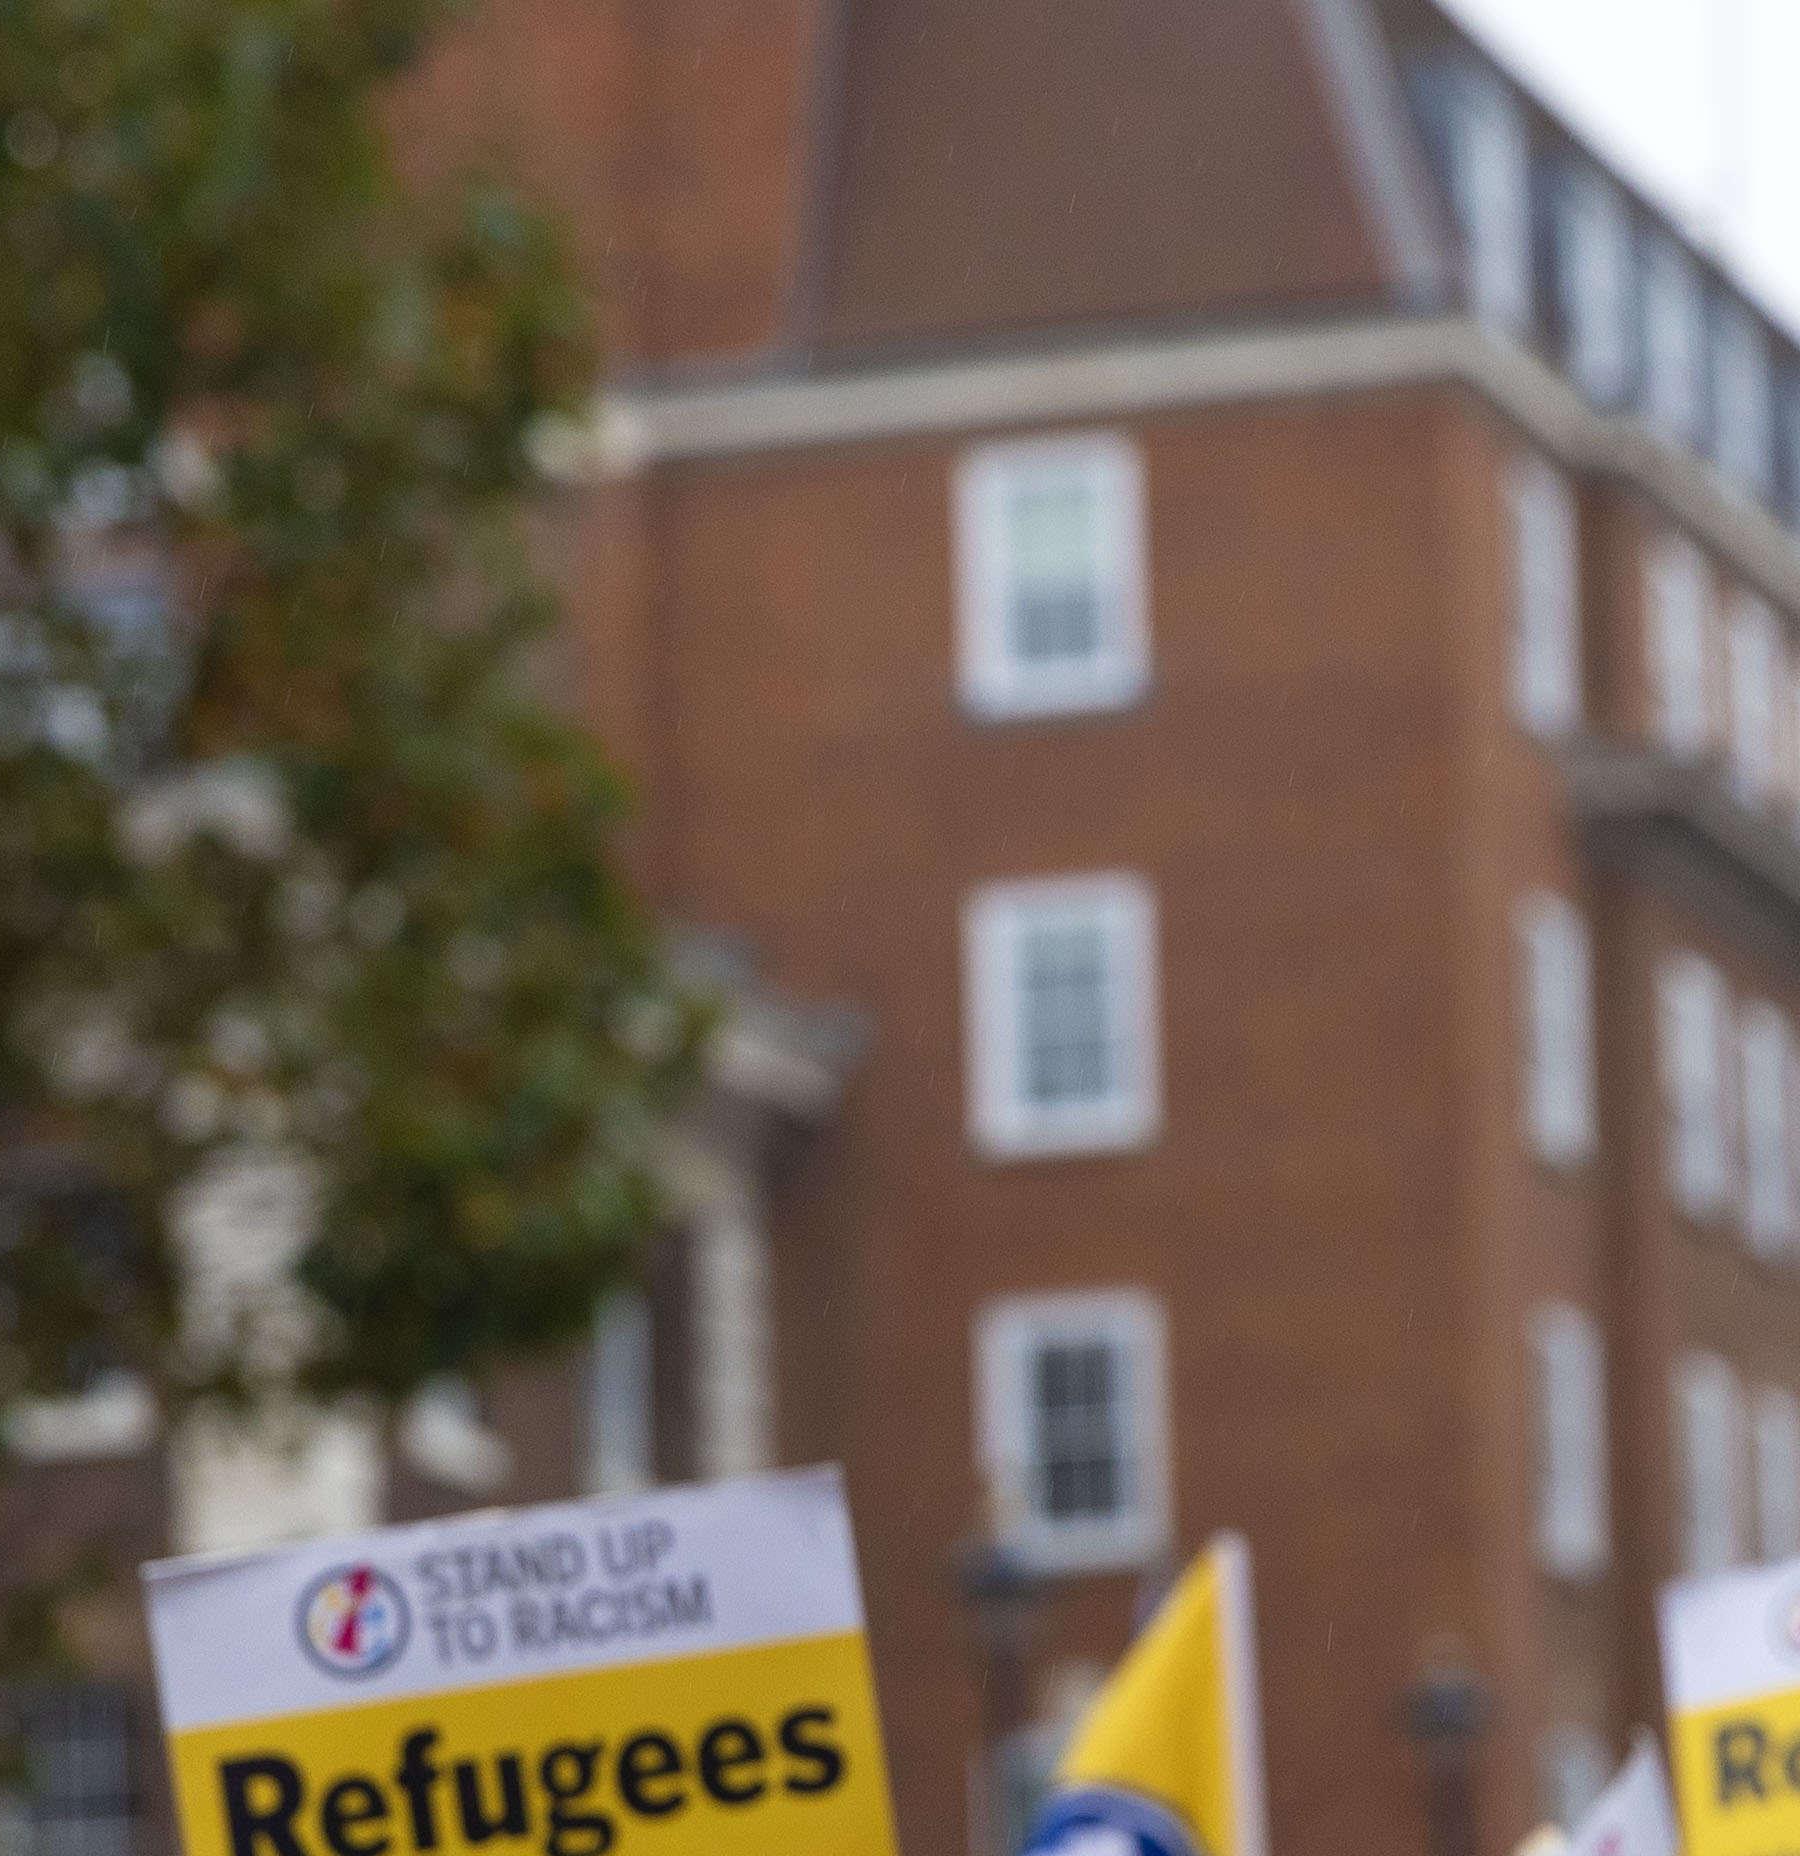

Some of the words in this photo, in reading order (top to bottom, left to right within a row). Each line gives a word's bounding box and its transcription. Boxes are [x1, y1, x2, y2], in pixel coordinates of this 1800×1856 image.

[412, 1531, 589, 1604] STAND
[598, 1519, 677, 1575] UP
[428, 1613, 498, 1671] TO
[509, 1575, 714, 1655] RACISM
